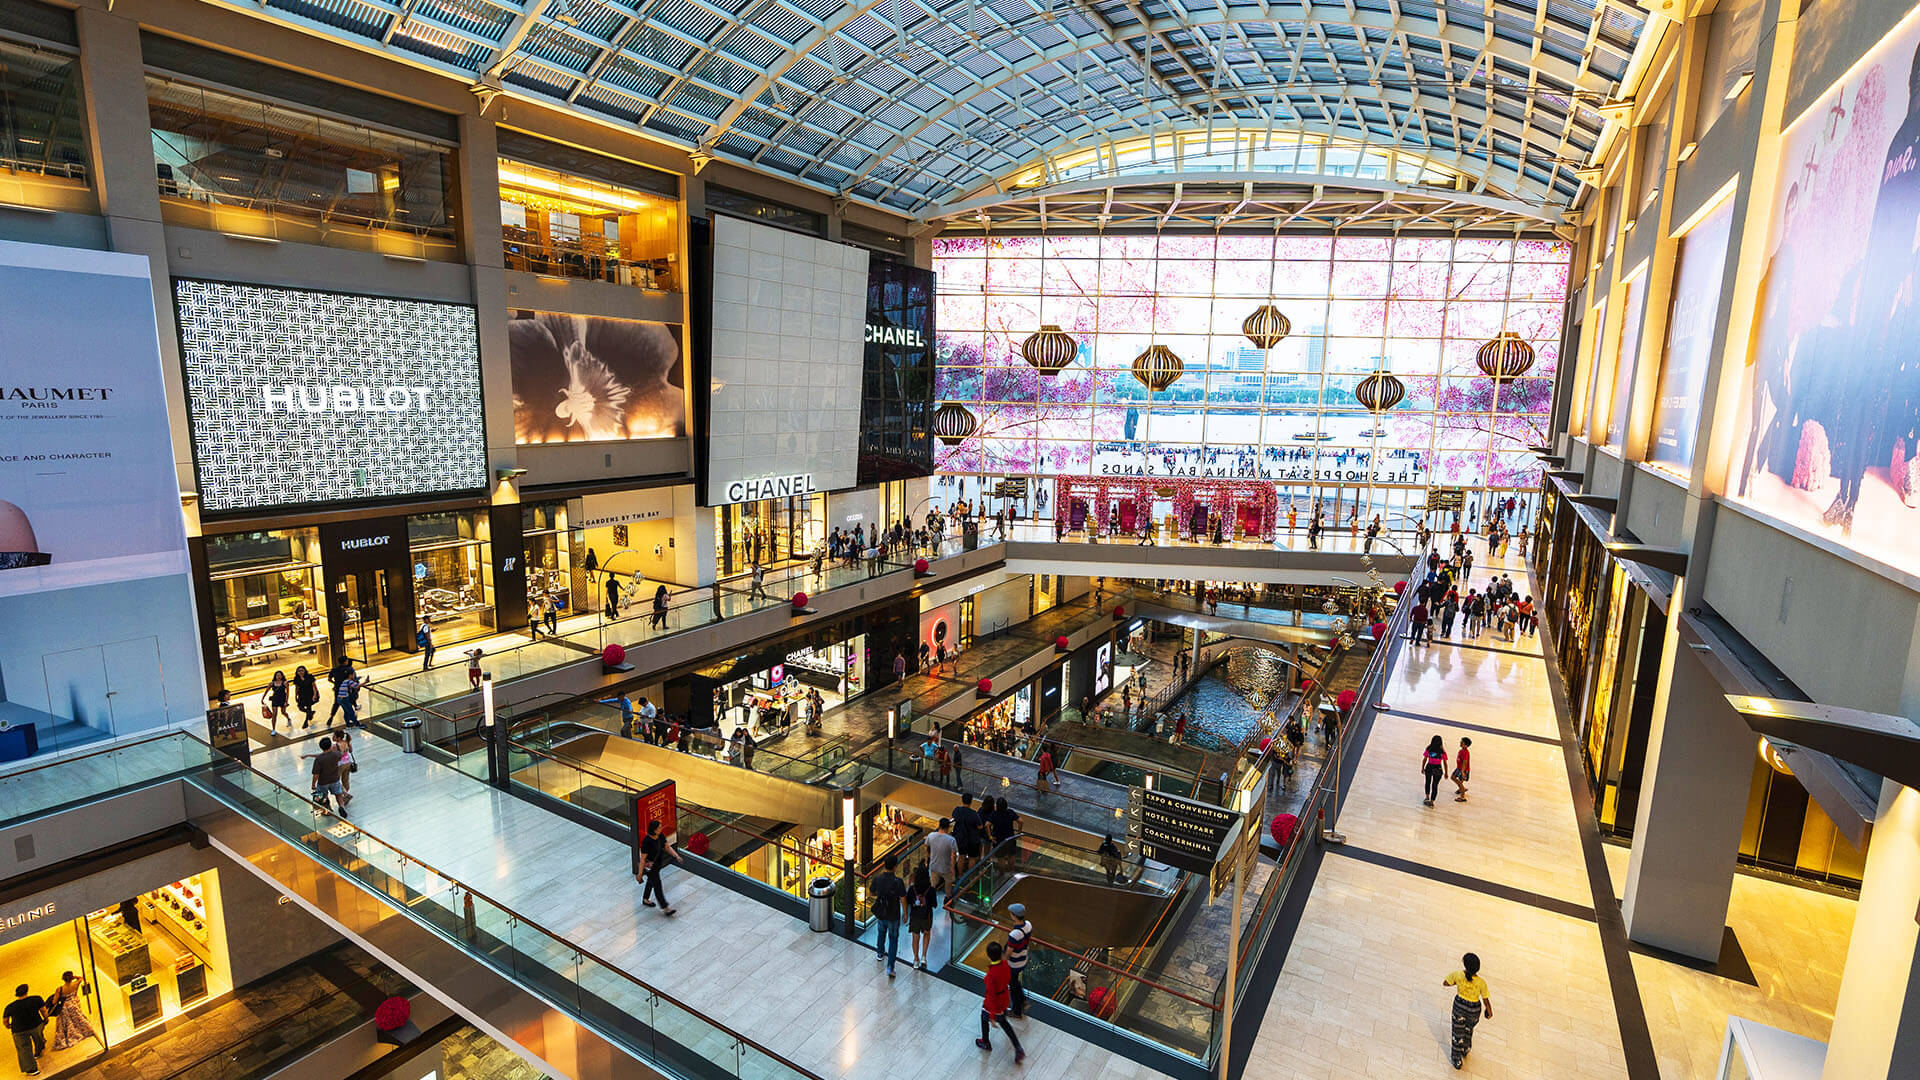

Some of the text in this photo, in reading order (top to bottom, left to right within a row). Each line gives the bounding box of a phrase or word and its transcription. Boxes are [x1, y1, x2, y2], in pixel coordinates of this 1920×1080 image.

[864, 323, 925, 347] CHANEL
[21, 401, 58, 409] PARIS
[263, 384, 433, 412] HUBLOT
[49, 452, 112, 461] CHARACTER
[727, 474, 816, 502] CHANEL
[585, 517, 619, 526] GARDENS
[341, 535, 391, 550] HUBLOT
[785, 645, 815, 661] CHANEL
[1146, 793, 1166, 804] EXPO
[1174, 802, 1230, 820] CONVENTION
[1145, 811, 1169, 823] HOTEL
[1178, 820, 1214, 835] SKYPARK
[1144, 827, 1170, 840] COACH
[1171, 835, 1211, 852] TERMINAL
